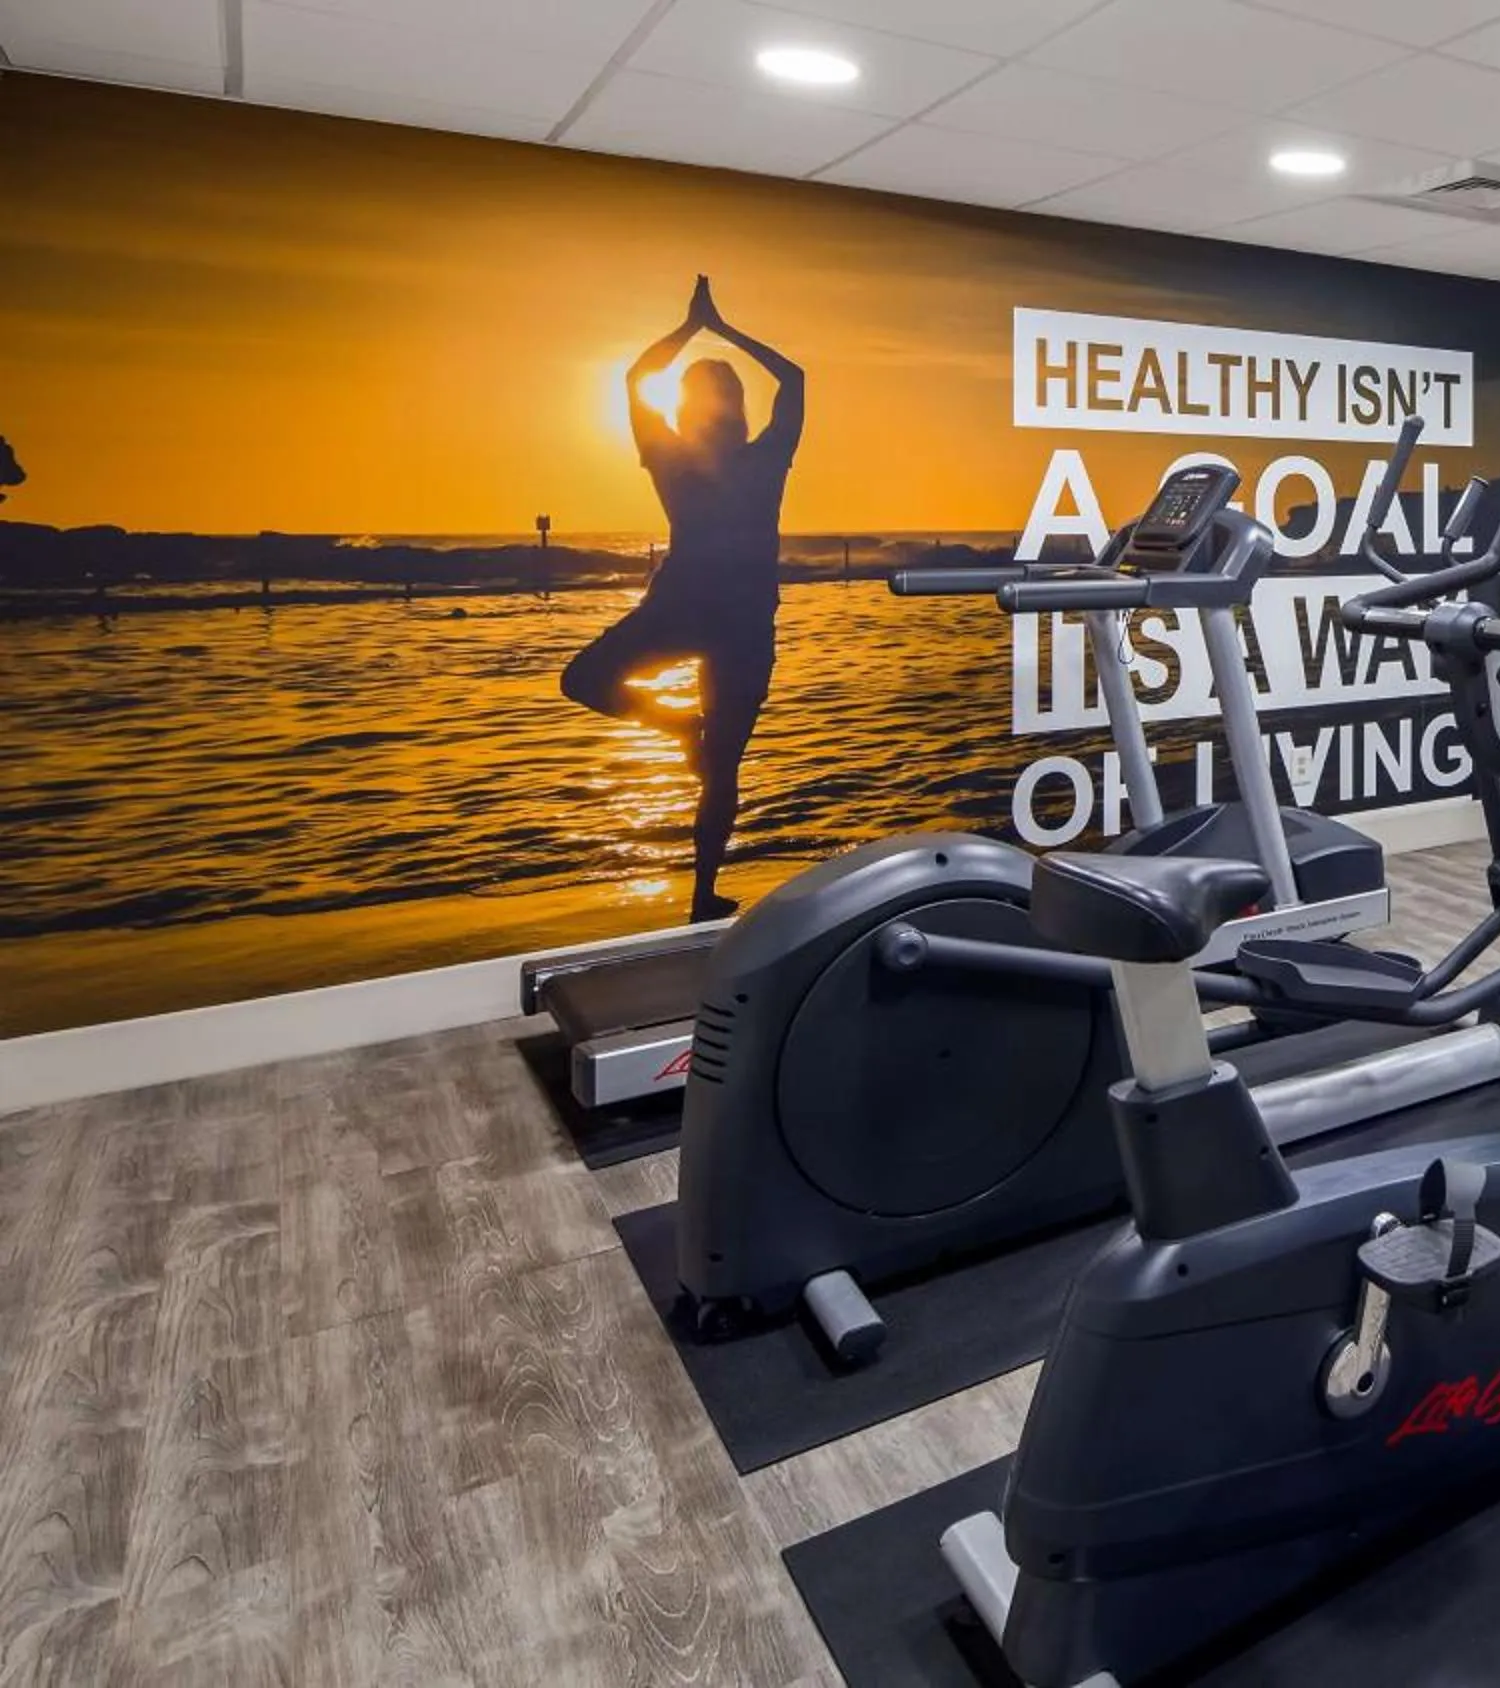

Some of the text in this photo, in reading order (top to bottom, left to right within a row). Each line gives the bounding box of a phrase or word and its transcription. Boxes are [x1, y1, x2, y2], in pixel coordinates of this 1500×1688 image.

[1034, 337, 1462, 430] HEALTHY ISN'T
[1013, 448, 1114, 561] A
[1293, 595, 1420, 688] WA
